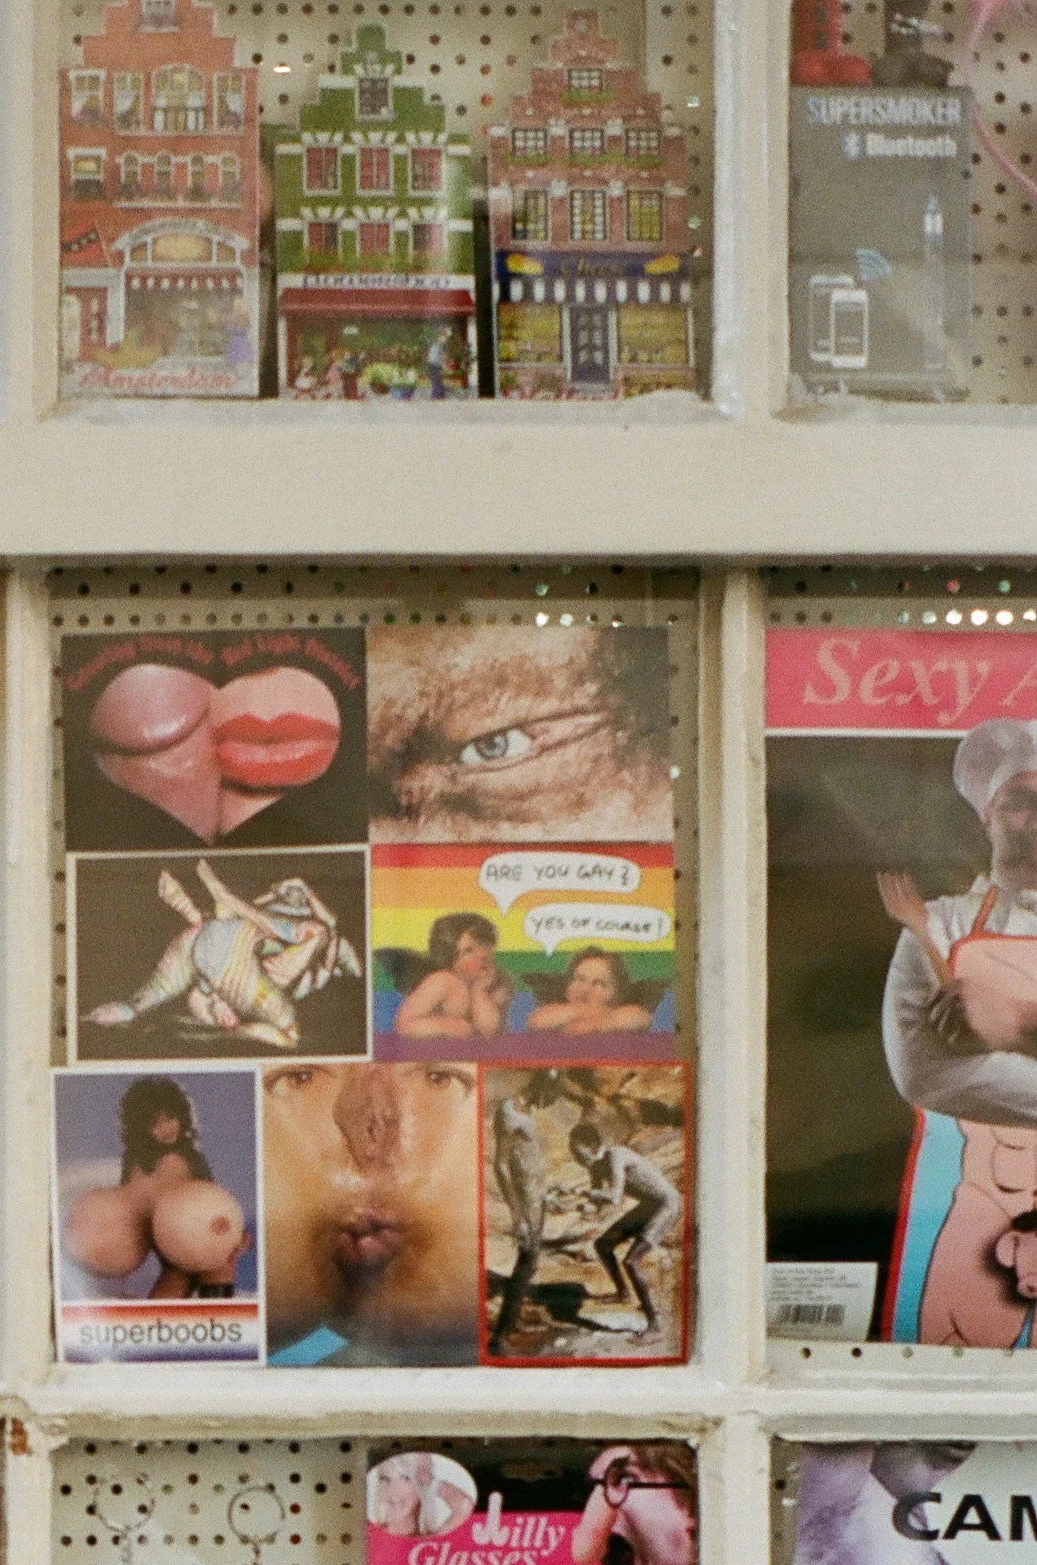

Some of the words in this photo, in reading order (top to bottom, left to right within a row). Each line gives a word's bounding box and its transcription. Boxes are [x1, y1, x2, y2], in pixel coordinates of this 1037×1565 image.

[806, 97, 961, 124] SUPERSMOKER
[866, 132, 956, 157] Bluetooth
[802, 636, 990, 725] Sexy
[485, 863, 522, 882] ARE
[533, 863, 569, 881] YOU
[531, 915, 564, 936] YES
[571, 917, 591, 928] OF
[80, 1317, 243, 1348] superboobs
